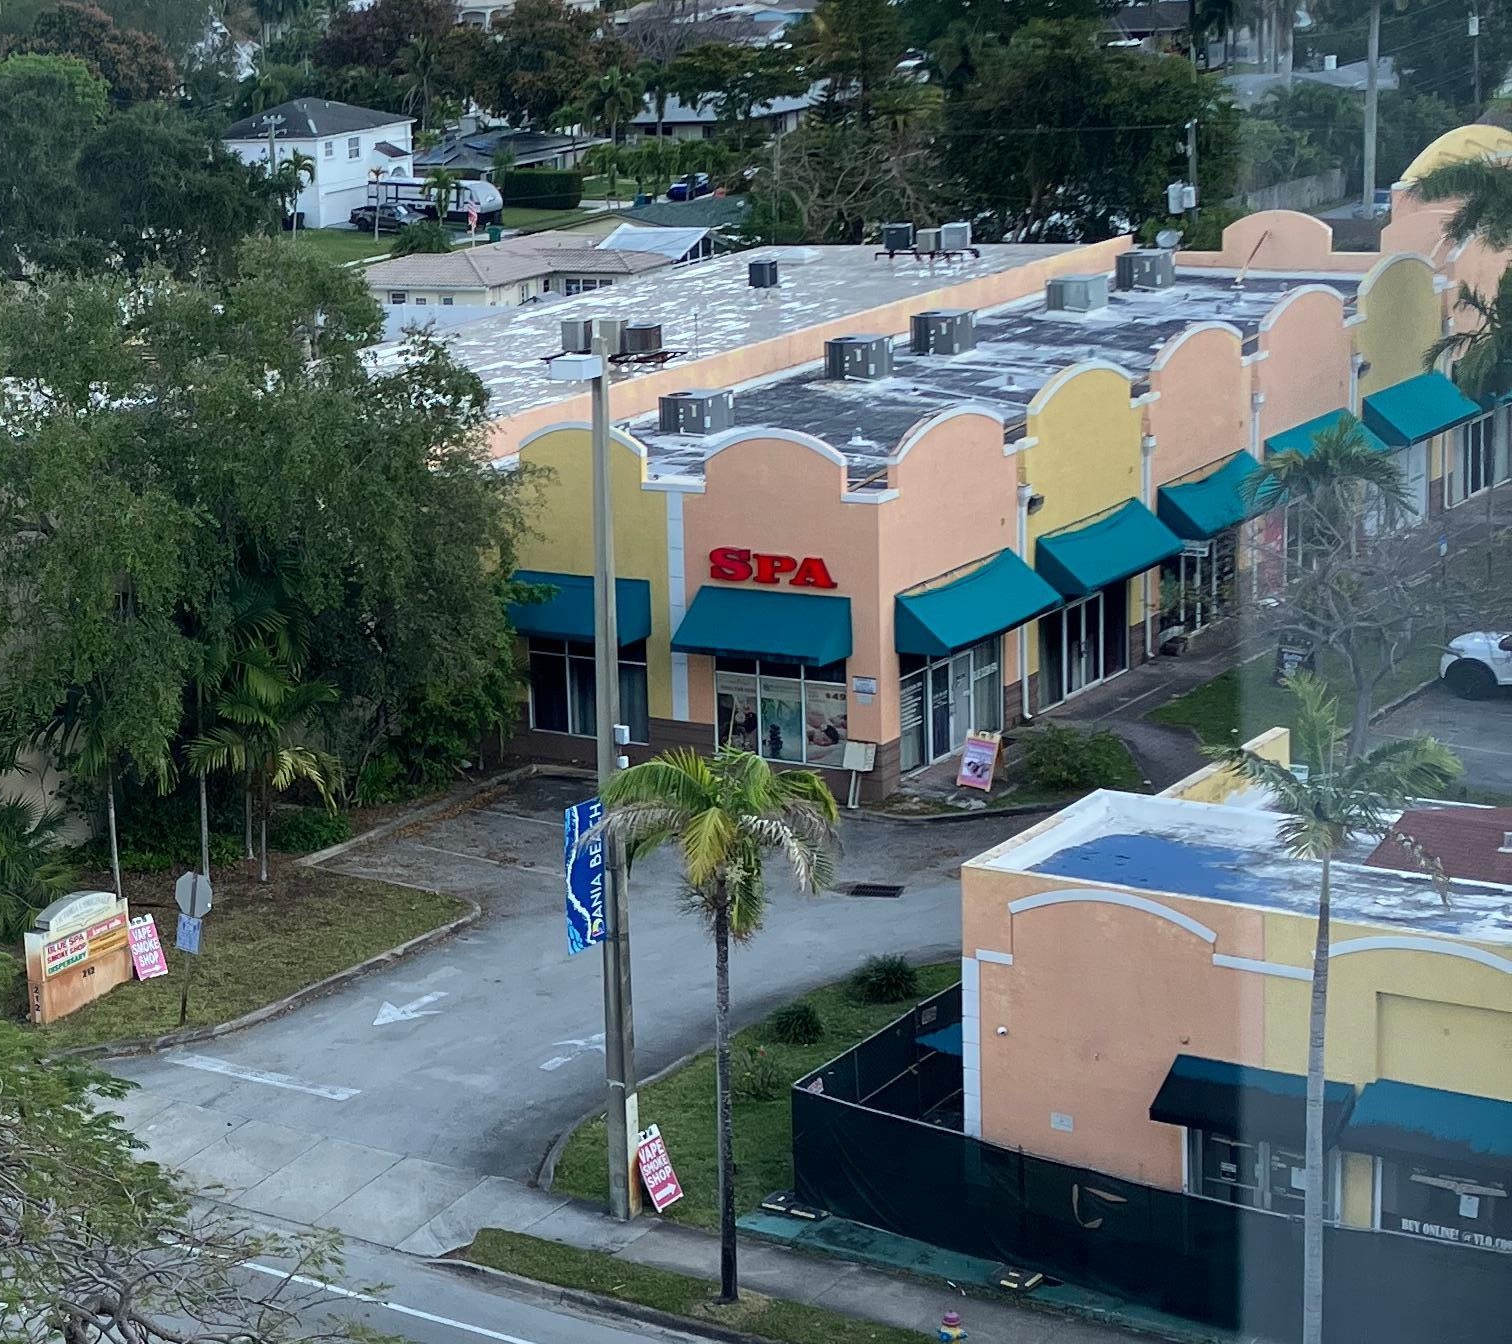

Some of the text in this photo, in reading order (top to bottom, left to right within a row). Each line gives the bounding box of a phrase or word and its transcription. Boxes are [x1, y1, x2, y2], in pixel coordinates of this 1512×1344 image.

[709, 547, 838, 589] SPA
[590, 872, 605, 938] DANIA
[48, 939, 67, 955] BLUE
[69, 933, 85, 946] SPA
[131, 925, 154, 942] VAPE
[131, 937, 161, 955] SMOKE
[138, 951, 160, 968] SHOP
[638, 1138, 665, 1164] VAPE
[642, 1154, 669, 1177] SMOKE
[648, 1166, 672, 1189] SHOP
